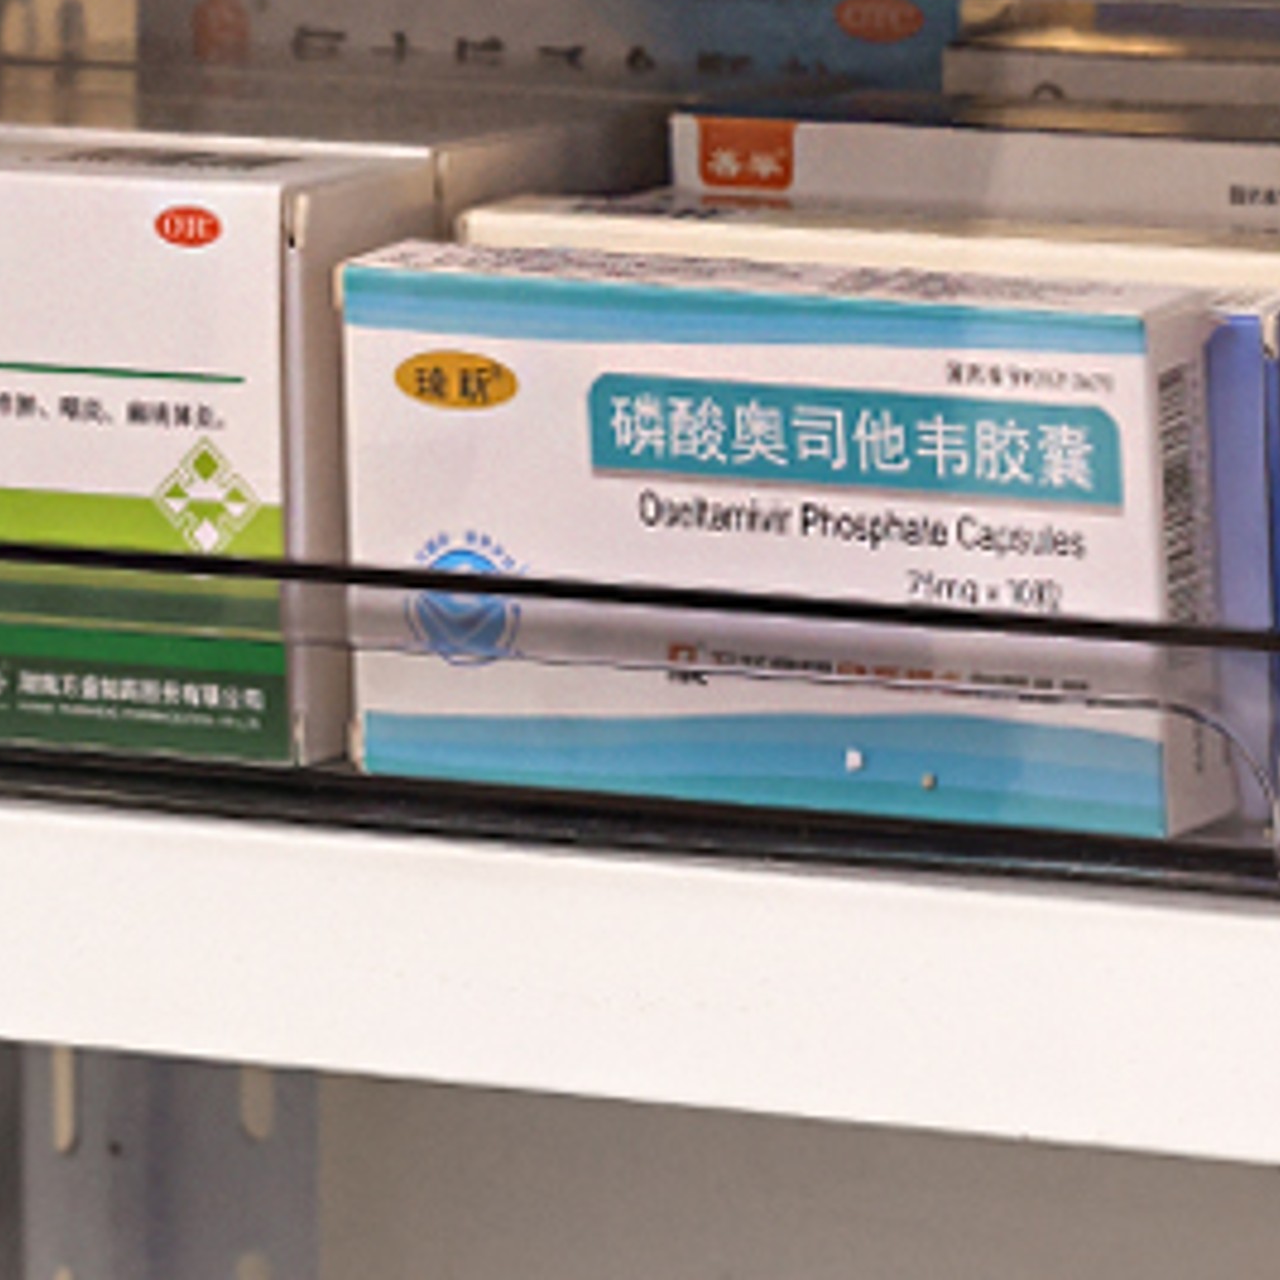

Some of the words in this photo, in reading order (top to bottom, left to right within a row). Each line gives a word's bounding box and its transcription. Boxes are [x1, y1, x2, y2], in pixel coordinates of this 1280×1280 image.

[158, 211, 219, 243] OTC
[609, 390, 1095, 492] 磷酸奥司他韦胶囊
[800, 502, 948, 551] Phosphate
[956, 515, 1088, 560] Capsules
